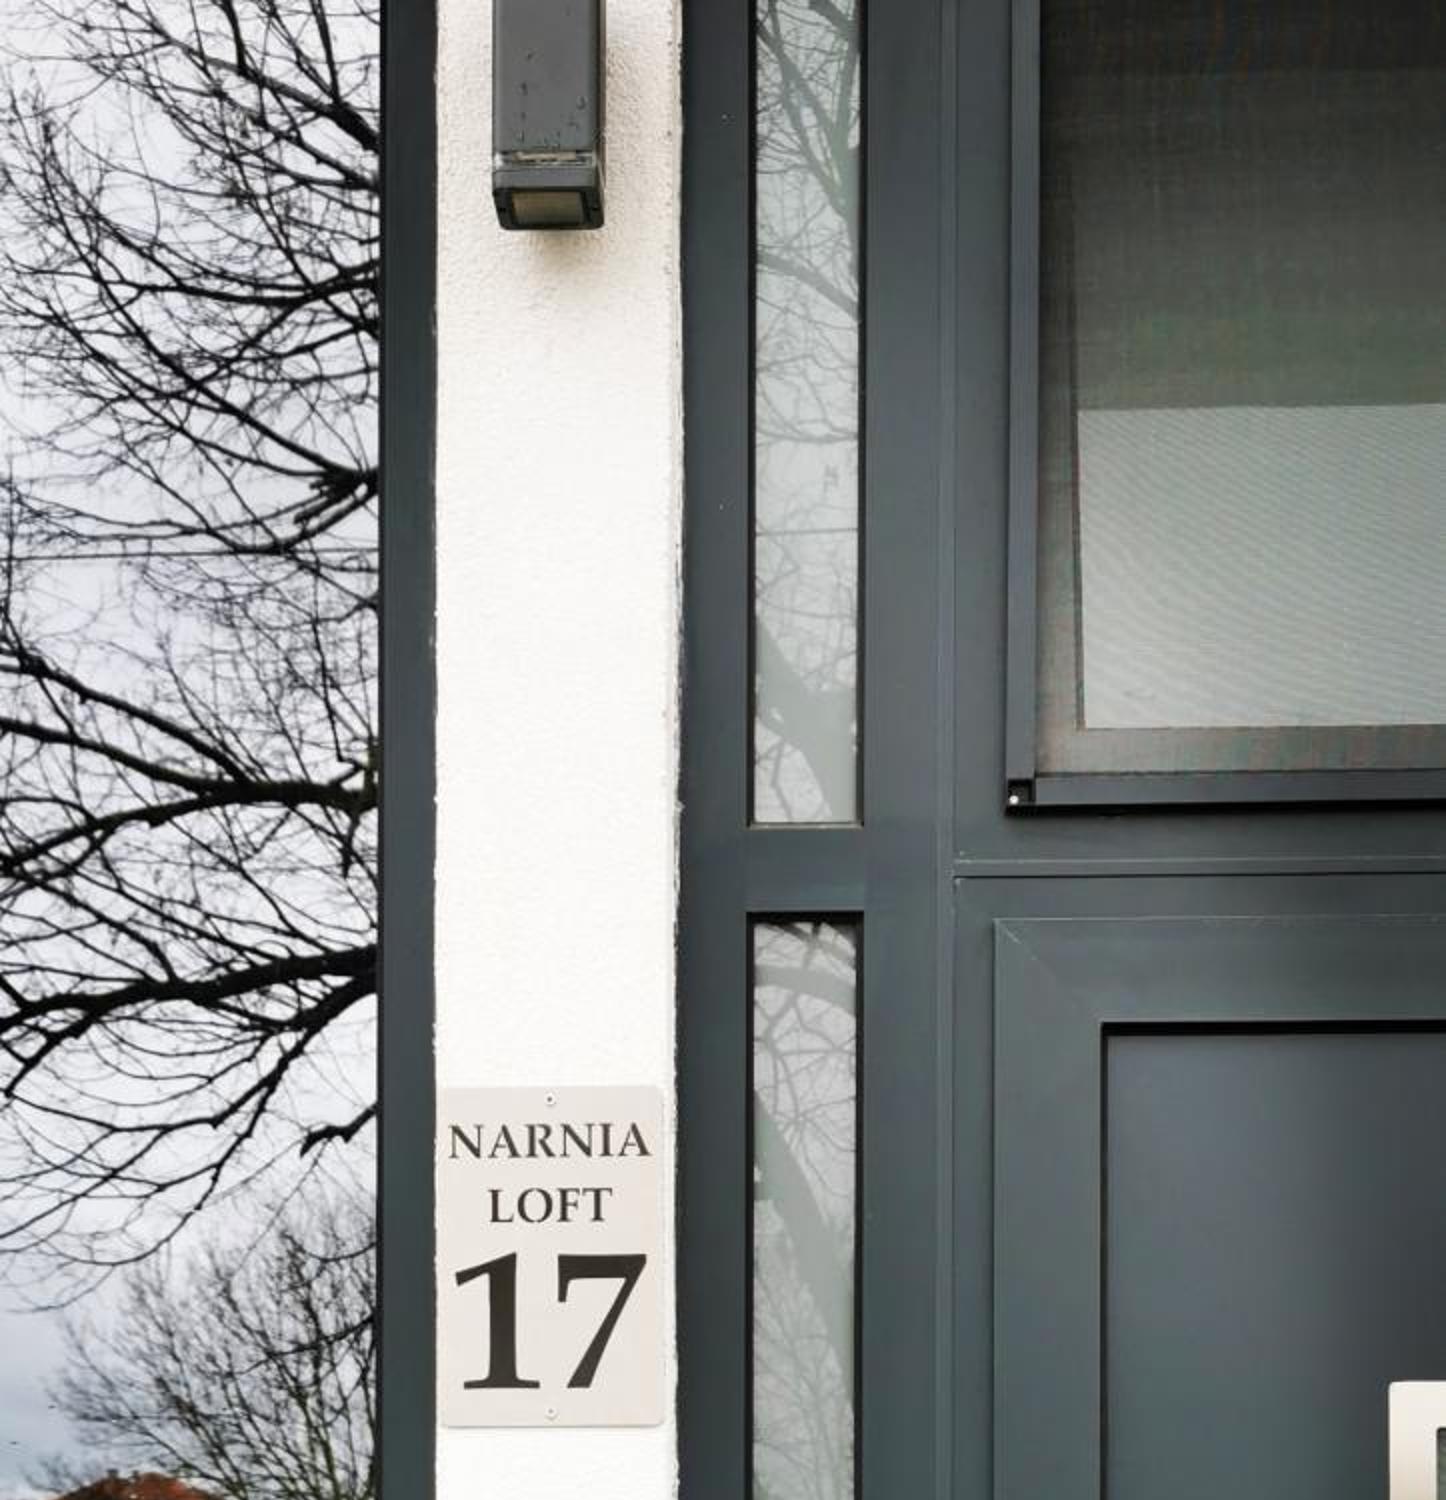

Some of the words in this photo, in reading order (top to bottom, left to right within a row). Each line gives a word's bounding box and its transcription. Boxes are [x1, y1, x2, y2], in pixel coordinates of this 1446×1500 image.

[449, 1122, 652, 1158] NARNIA
[487, 1187, 613, 1223] LOFT
[454, 1252, 647, 1389] 17
